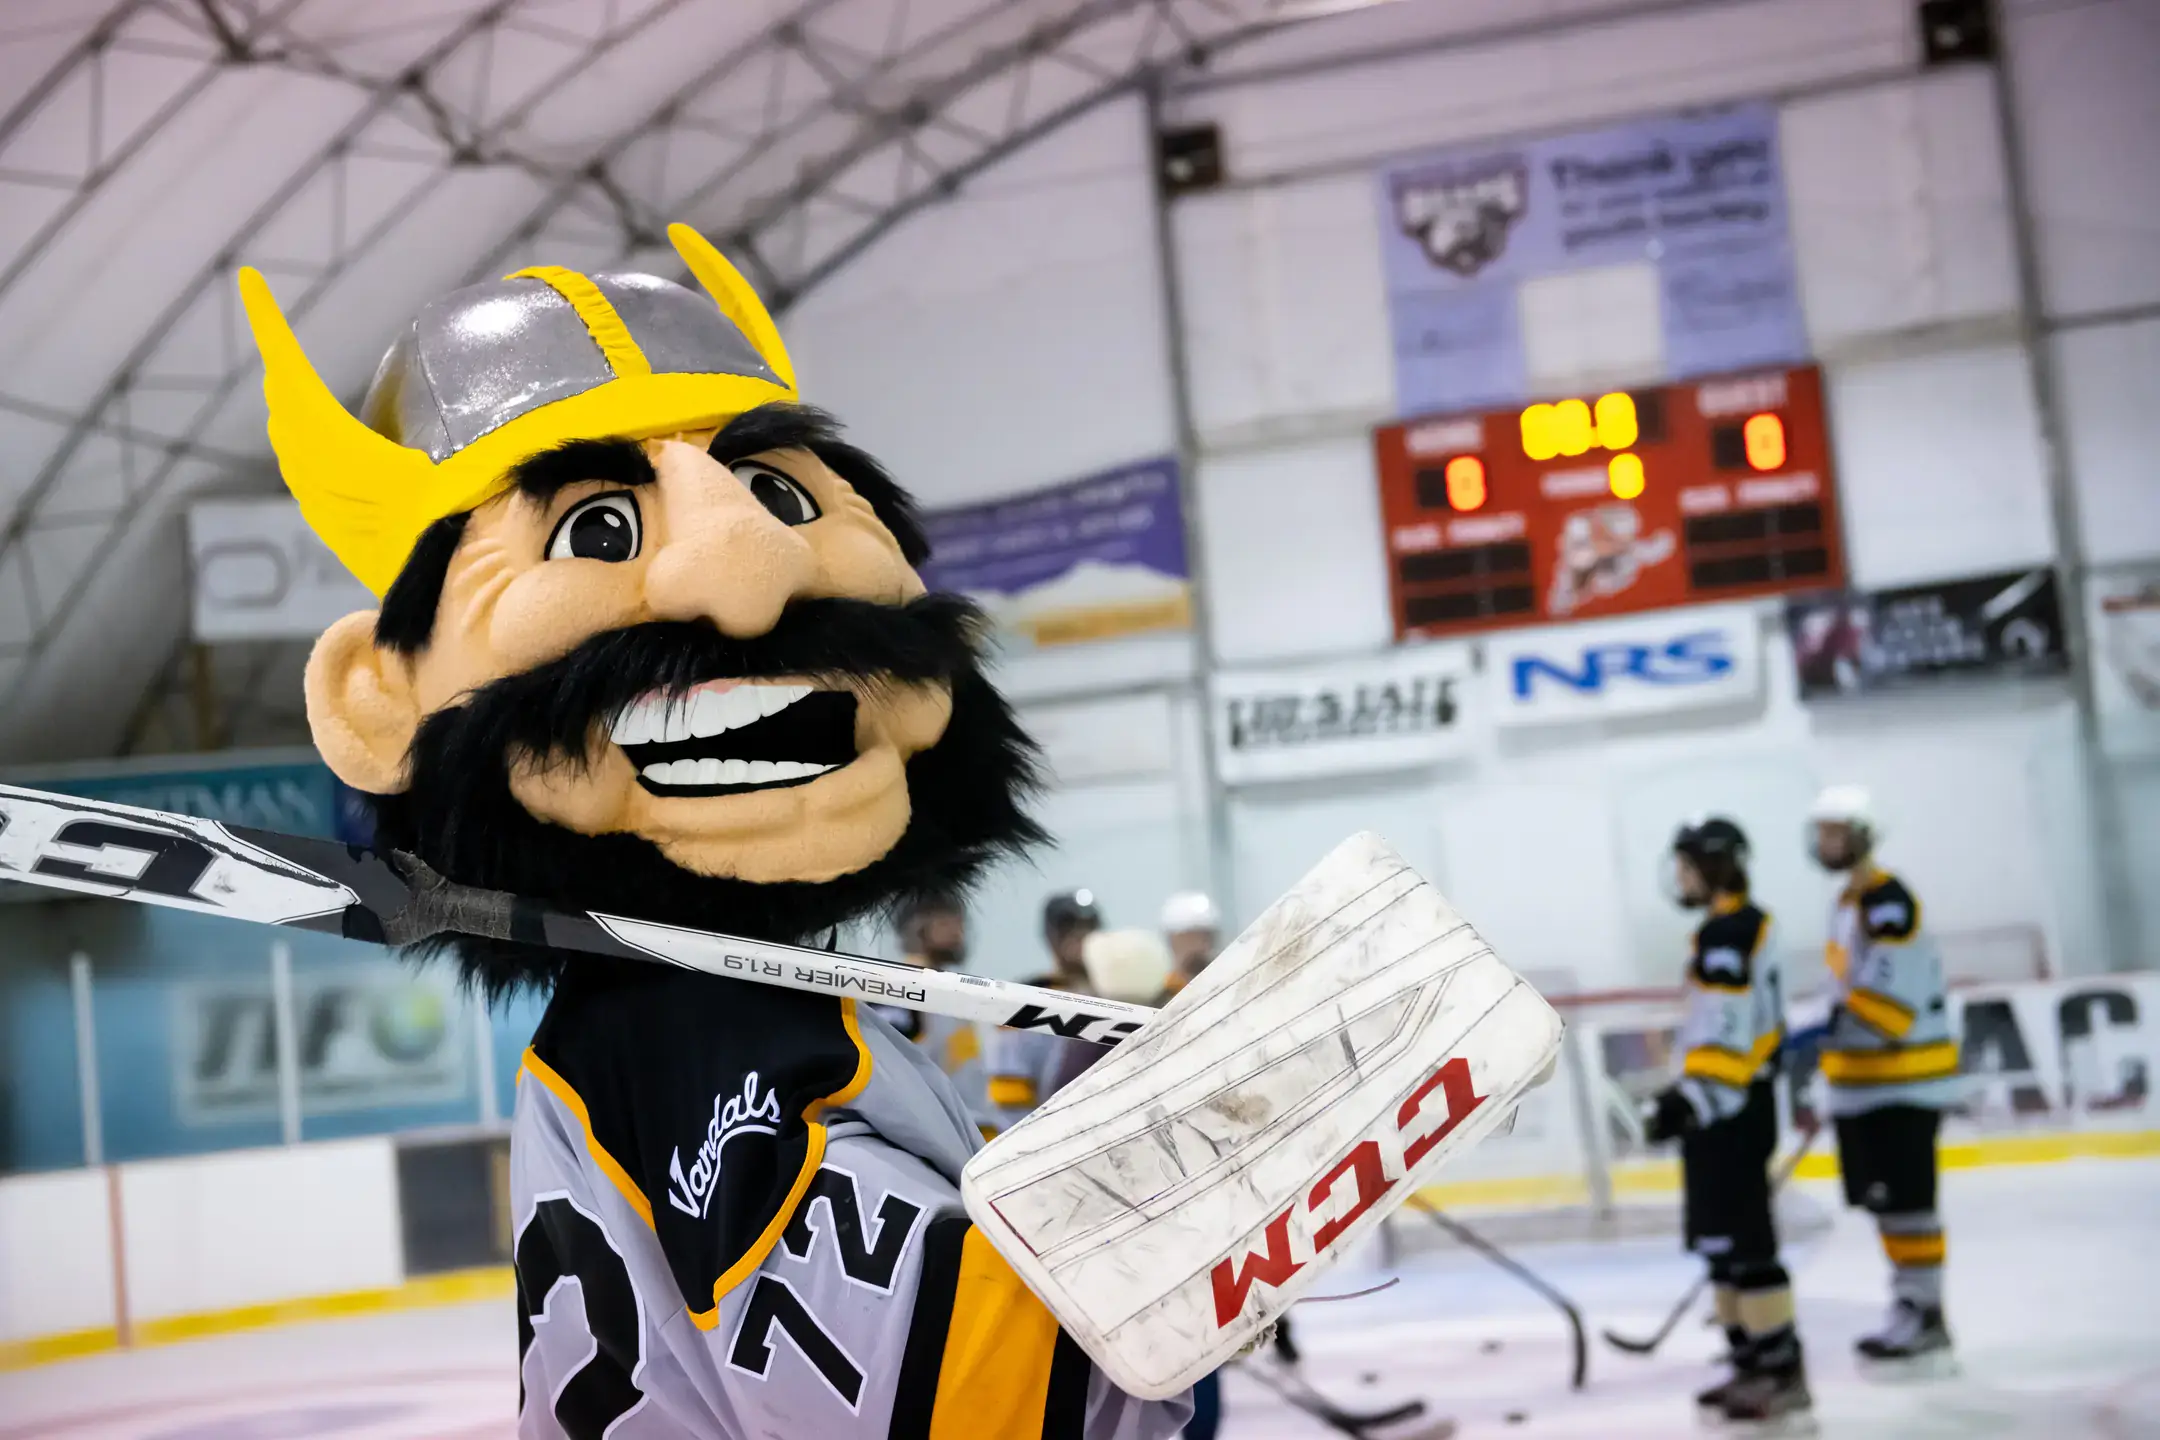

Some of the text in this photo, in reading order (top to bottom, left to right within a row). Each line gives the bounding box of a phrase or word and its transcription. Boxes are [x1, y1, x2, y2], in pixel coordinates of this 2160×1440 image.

[1511, 629, 1734, 700] NRS
[723, 954, 926, 1002] PREMIER R1.9
[668, 1070, 781, 1219] Vandals
[1209, 1057, 1490, 1330] CCM
[724, 1161, 928, 1418] 72
